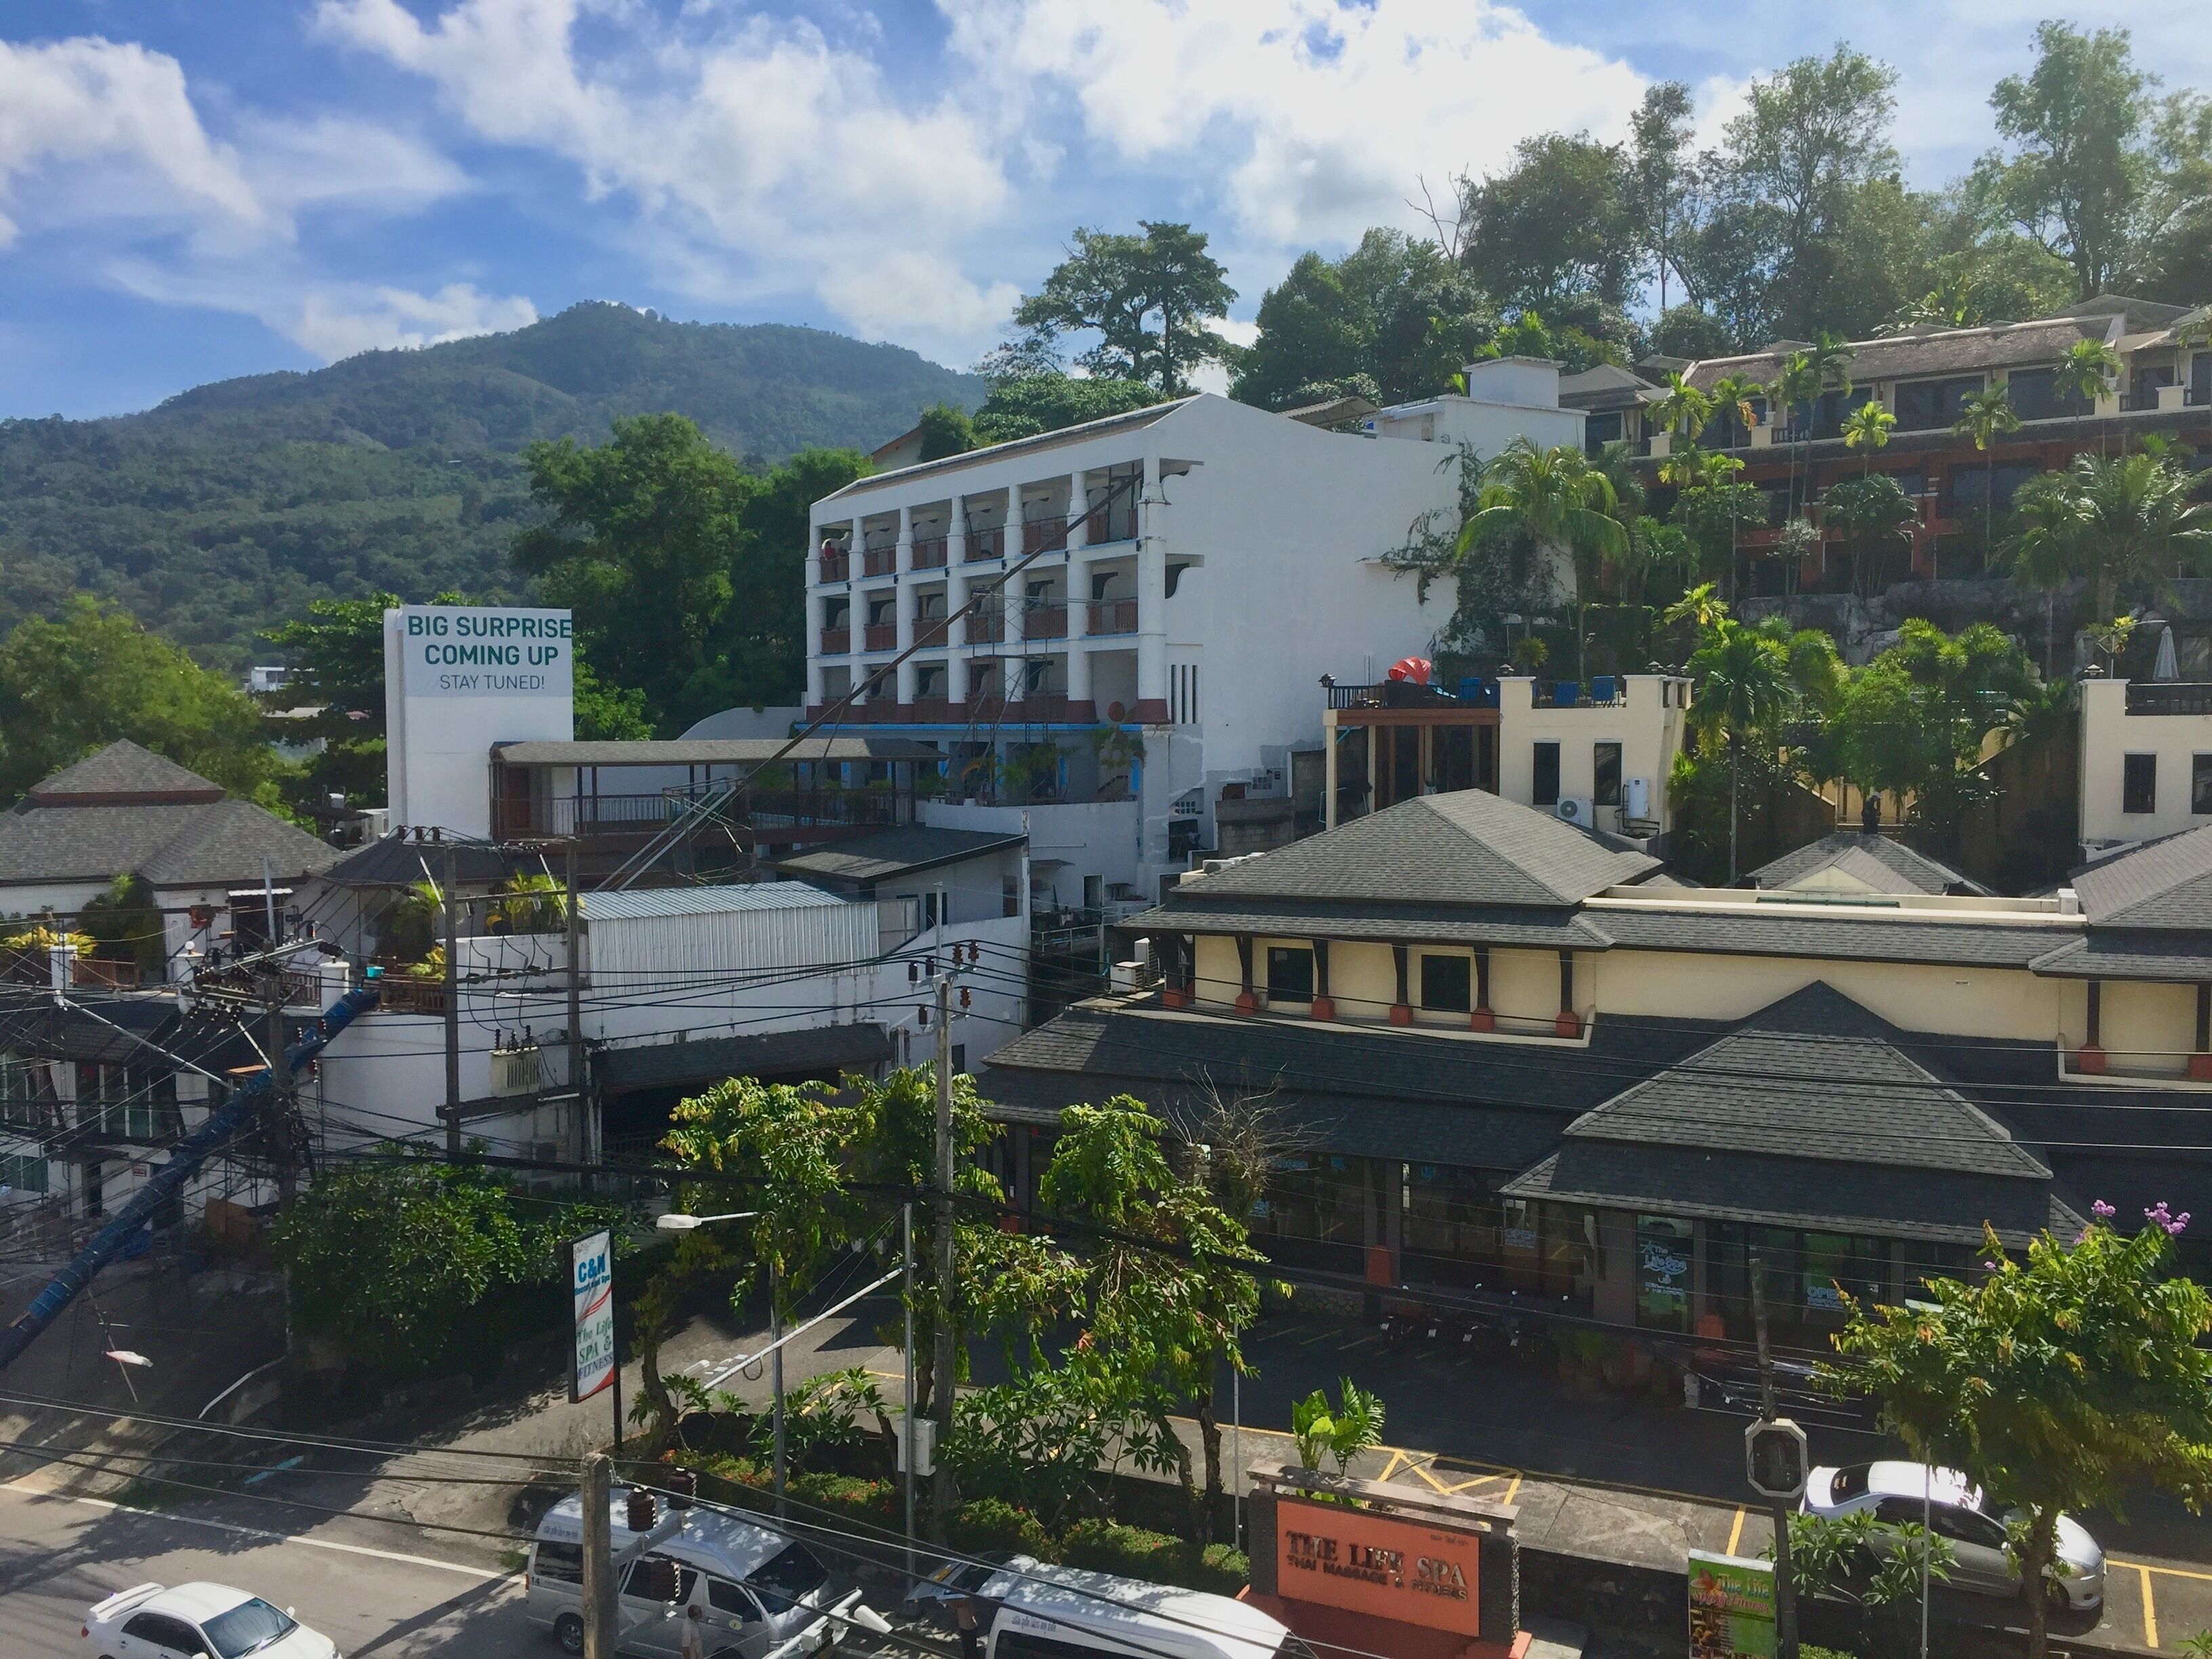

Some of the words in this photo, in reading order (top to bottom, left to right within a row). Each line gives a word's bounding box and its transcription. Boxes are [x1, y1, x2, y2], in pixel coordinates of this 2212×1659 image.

[408, 615, 448, 636] BIG
[456, 616, 572, 638] SURPRISE
[425, 644, 520, 665] COMING
[528, 646, 558, 665] UP
[440, 674, 479, 690] STAY
[483, 675, 545, 690] TUNED!
[578, 1254, 607, 1283] C&N
[1807, 1286, 1839, 1300] OPE
[576, 1328, 593, 1345] The
[596, 1316, 613, 1336] Life
[578, 1340, 598, 1365] SPA
[603, 1336, 611, 1351] &
[577, 1353, 613, 1380] FITNESS
[1286, 1530, 1338, 1562] THE
[1349, 1542, 1405, 1575] LIFE
[1416, 1556, 1467, 1589] SPA
